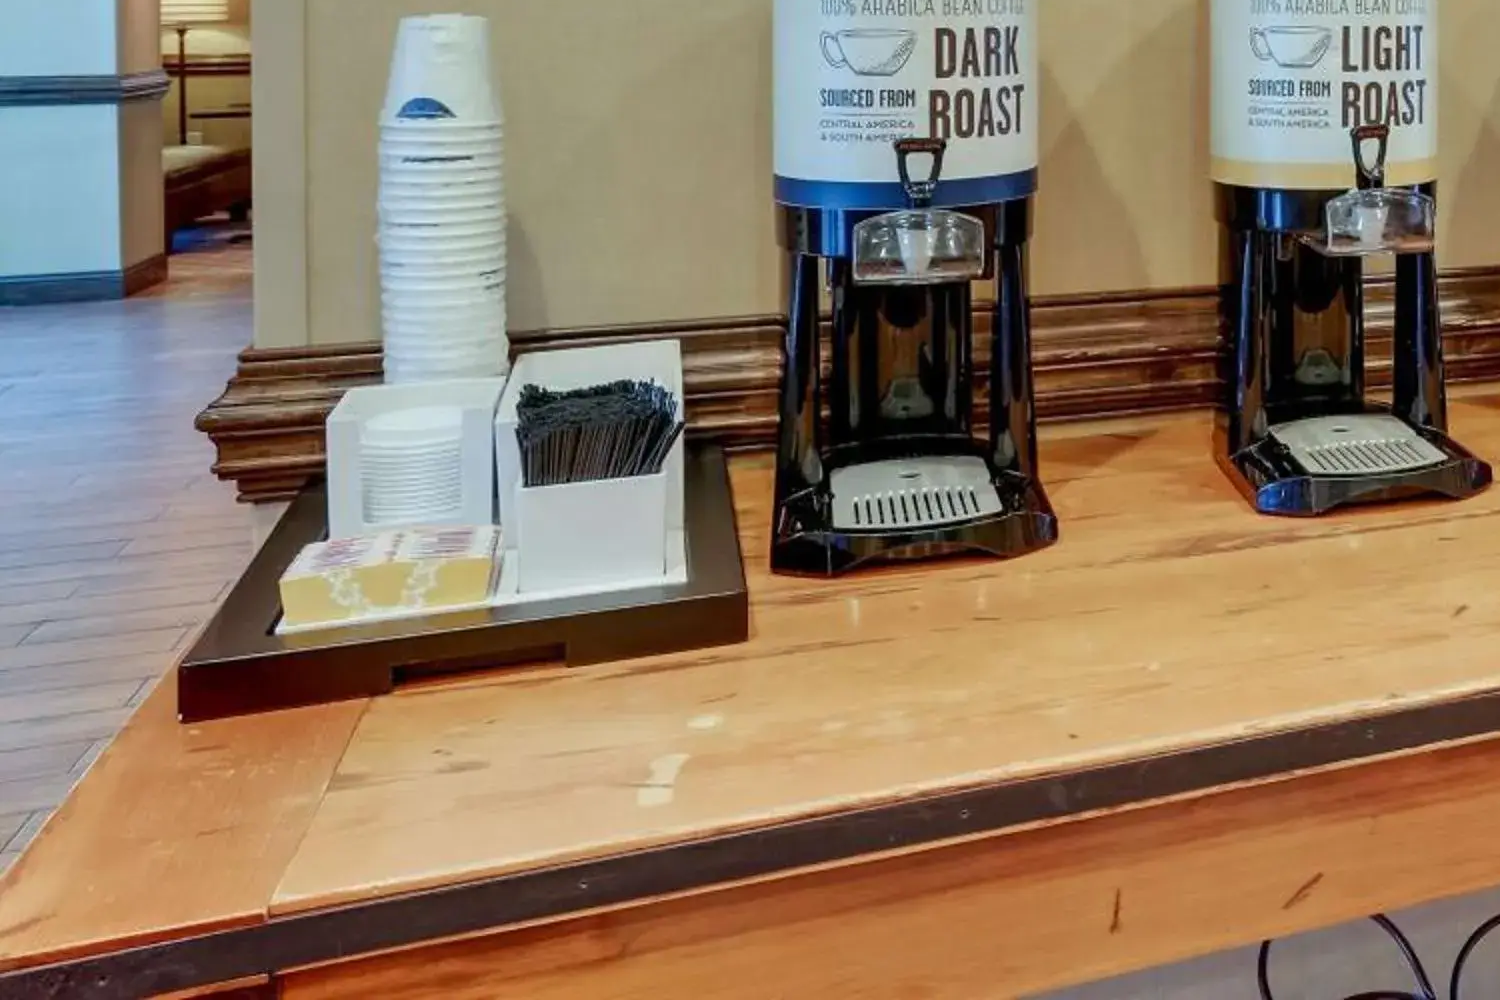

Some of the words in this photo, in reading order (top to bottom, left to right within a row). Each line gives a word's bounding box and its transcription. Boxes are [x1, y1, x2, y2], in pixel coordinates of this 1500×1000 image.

[935, 25, 1019, 78] DARK
[1342, 25, 1423, 72] LIGHT
[819, 88, 875, 108] SOURCED
[879, 88, 916, 108] FROM
[928, 84, 1024, 140] ROAST
[1247, 79, 1295, 97] SOURCED
[1299, 80, 1332, 98] FROM
[1342, 79, 1427, 128] ROAST
